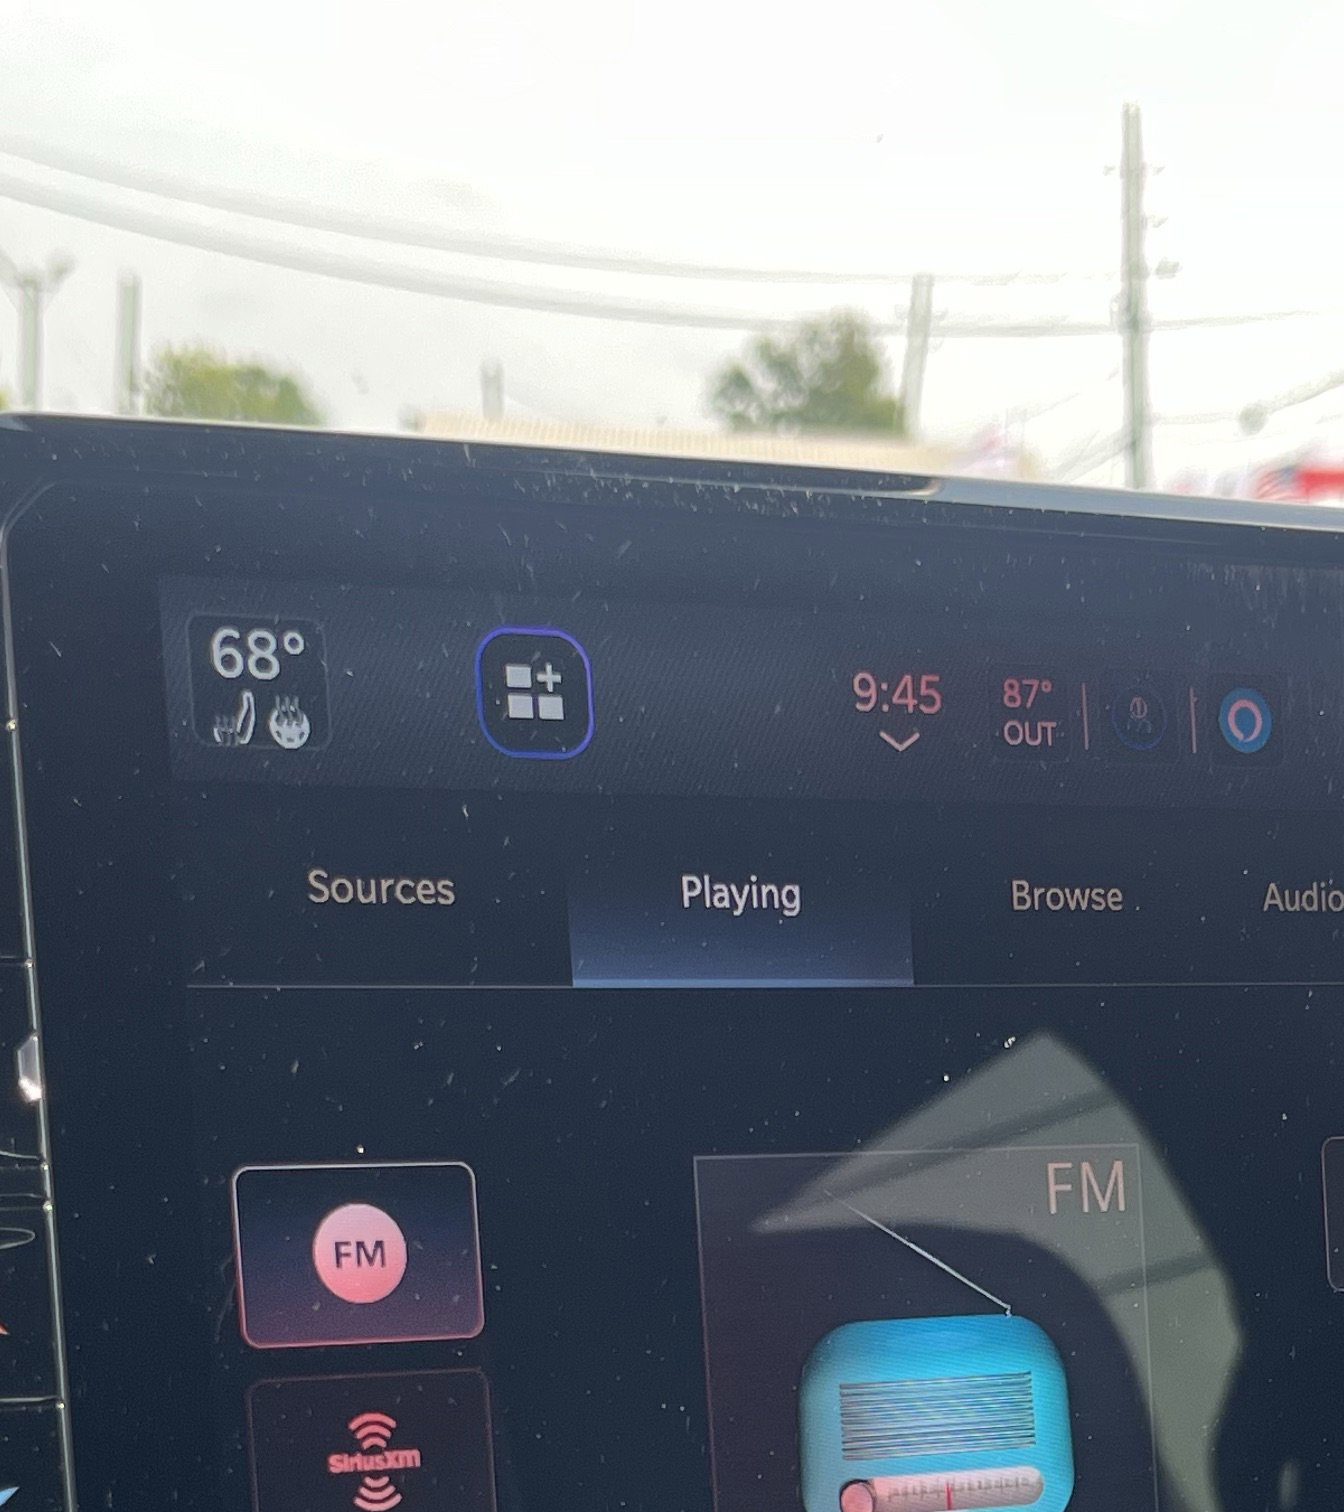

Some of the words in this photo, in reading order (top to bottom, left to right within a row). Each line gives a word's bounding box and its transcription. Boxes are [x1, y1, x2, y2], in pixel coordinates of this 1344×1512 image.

[209, 628, 305, 680] 68°
[852, 672, 942, 716] 9:45
[1002, 678, 1054, 708] 87°
[1002, 719, 1058, 748] OUT
[307, 868, 456, 907] Sources
[680, 873, 803, 918] Playing
[1010, 880, 1124, 913] Browse
[1262, 881, 1344, 915] Audio
[1045, 1158, 1127, 1215] FM
[334, 1239, 387, 1270] FM
